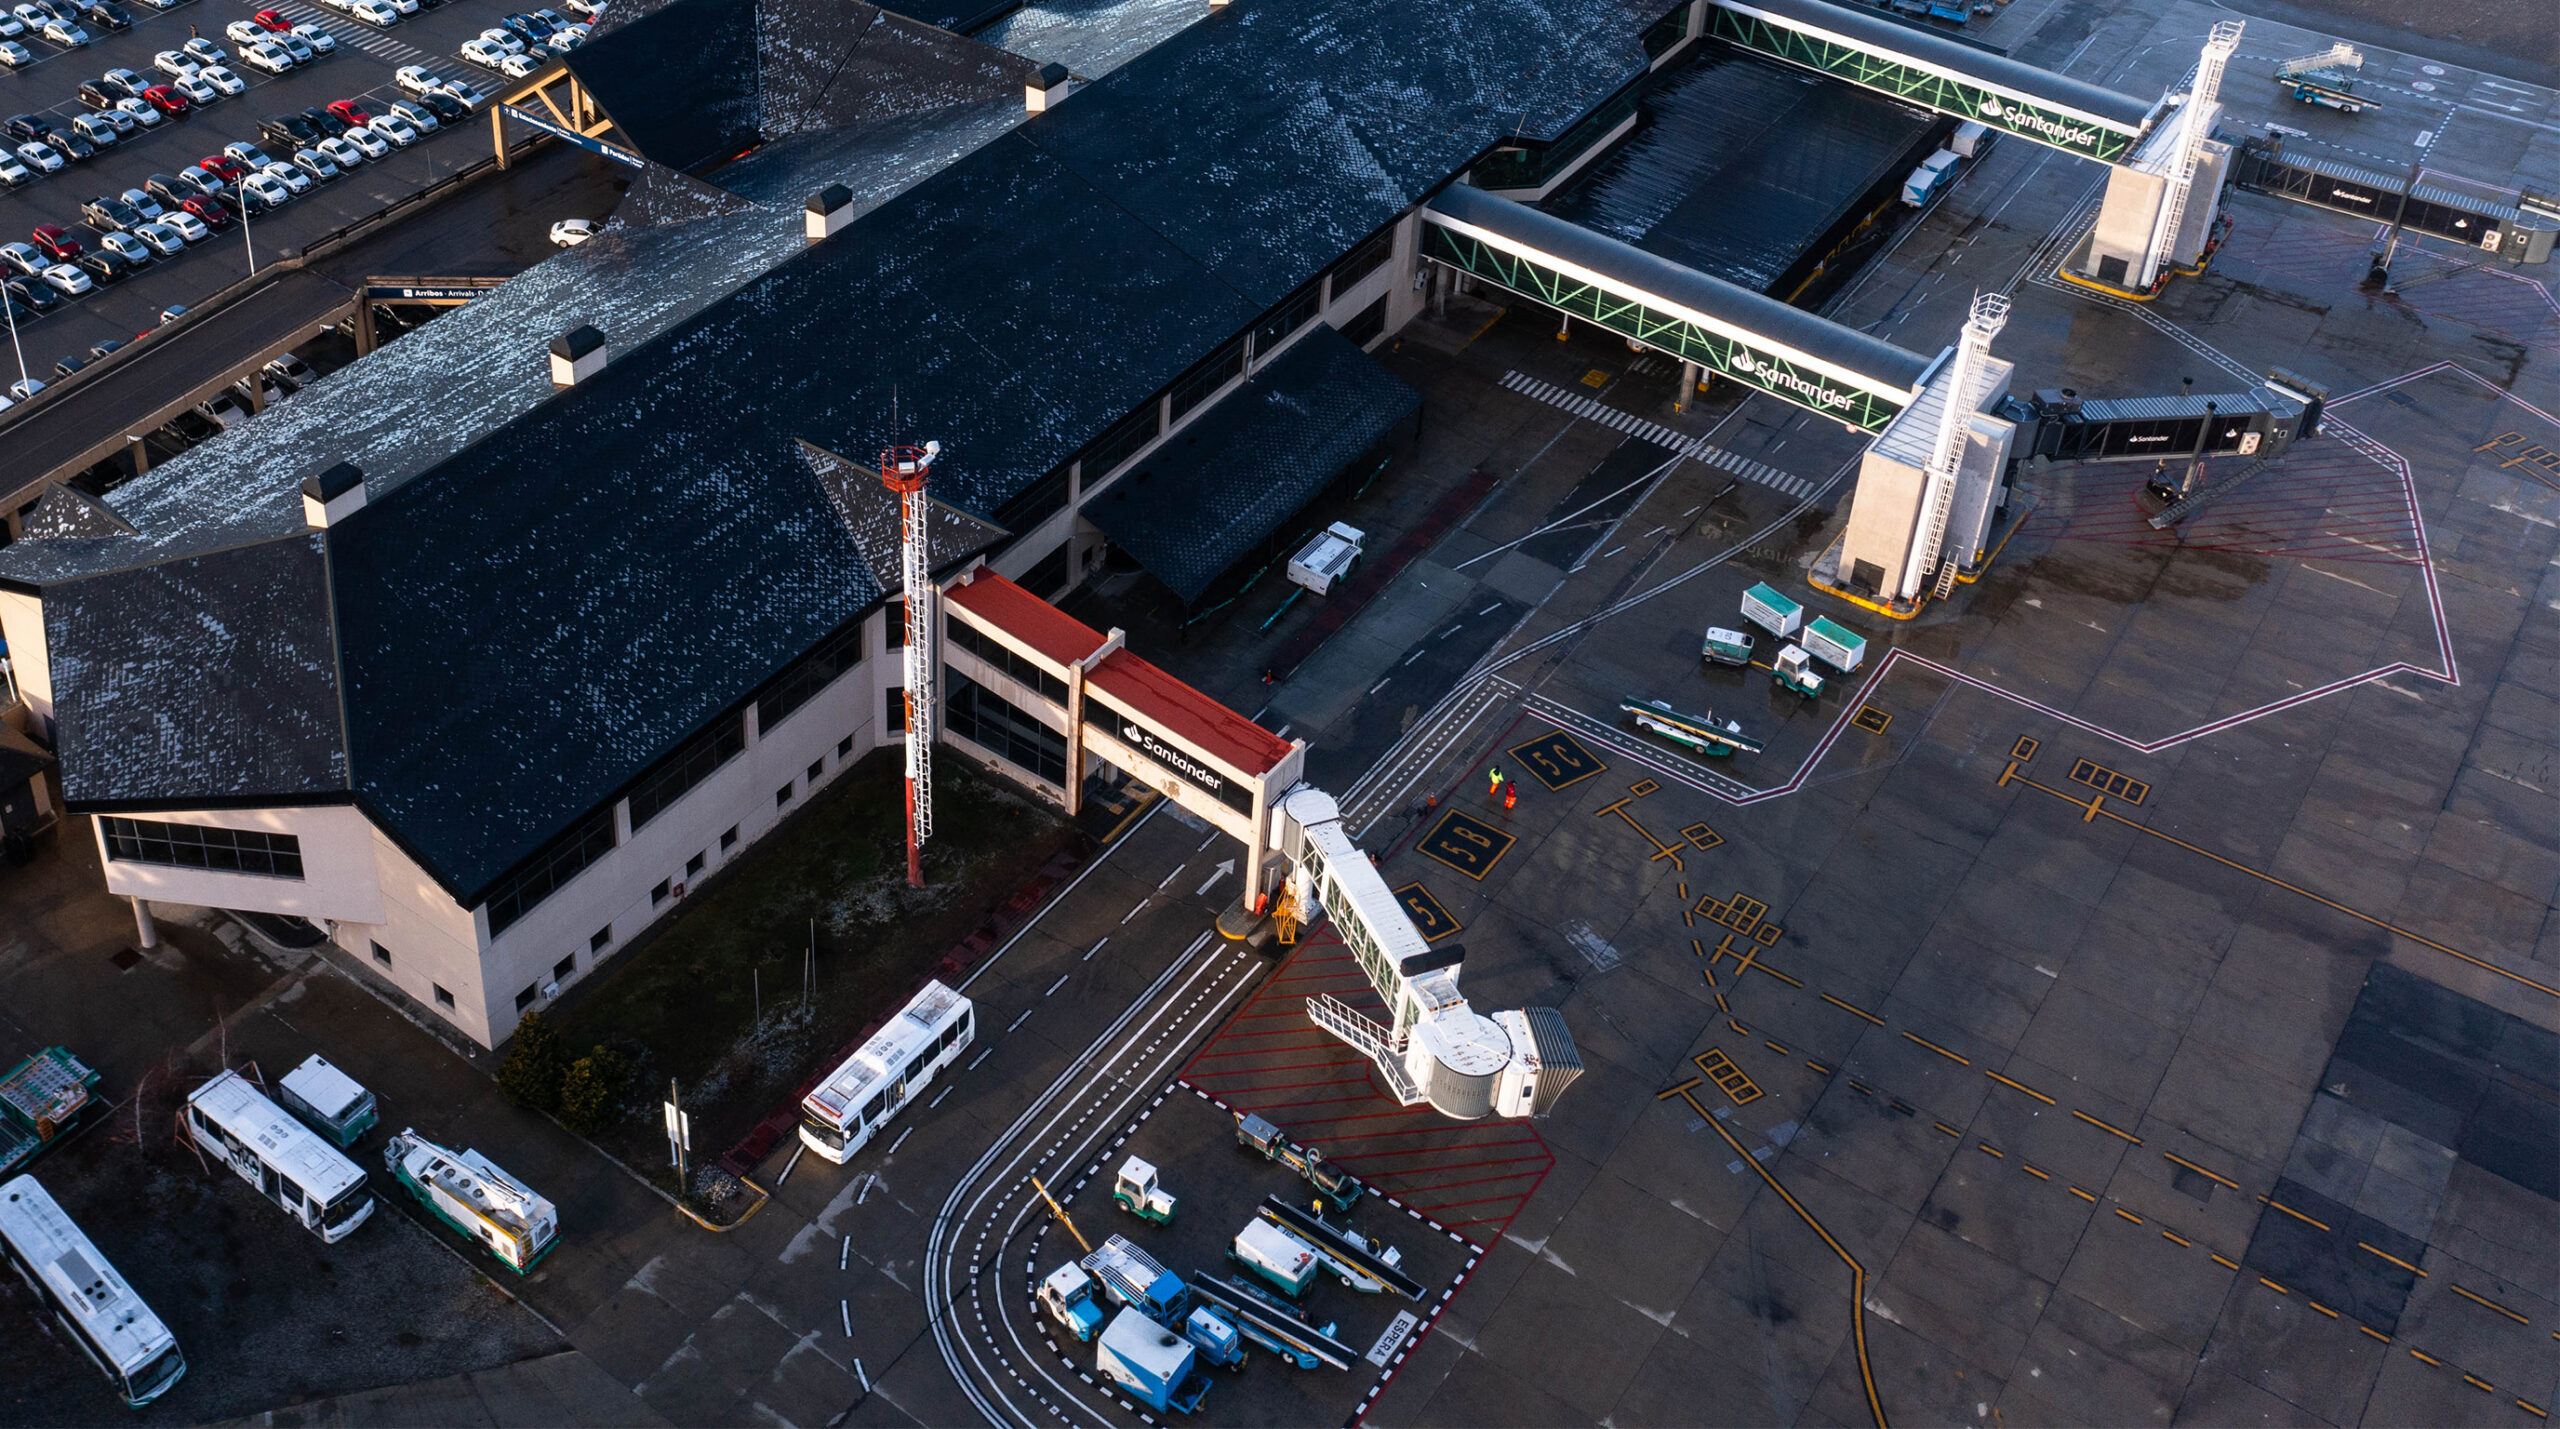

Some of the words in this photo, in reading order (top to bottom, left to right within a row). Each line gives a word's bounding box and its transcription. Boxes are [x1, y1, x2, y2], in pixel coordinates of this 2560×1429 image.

[2003, 106, 2096, 146] Santander
[2340, 191, 2372, 204] Santander
[1754, 361, 1856, 411] Santander
[1143, 736, 1221, 789] Santander
[1374, 1319, 1409, 1357] ESPERA
